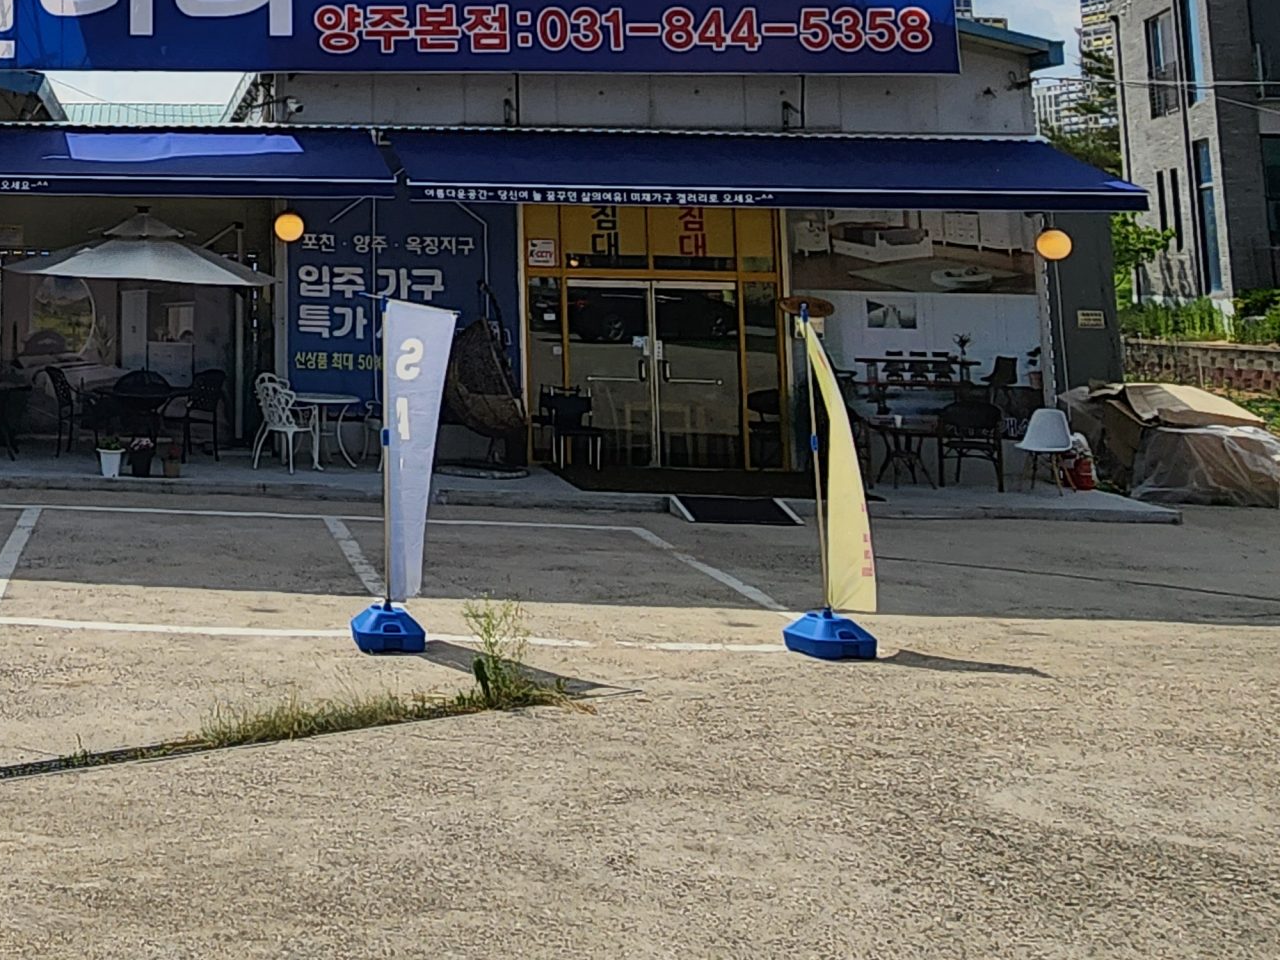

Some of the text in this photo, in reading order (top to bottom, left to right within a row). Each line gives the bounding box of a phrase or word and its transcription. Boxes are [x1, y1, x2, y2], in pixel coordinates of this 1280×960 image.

[301, 233, 476, 257] 포천 양주 옥정지구
[297, 265, 446, 301] 입주 가구
[297, 304, 368, 340] 특가
[294, 351, 328, 370] 신상품
[331, 352, 354, 371] 최대
